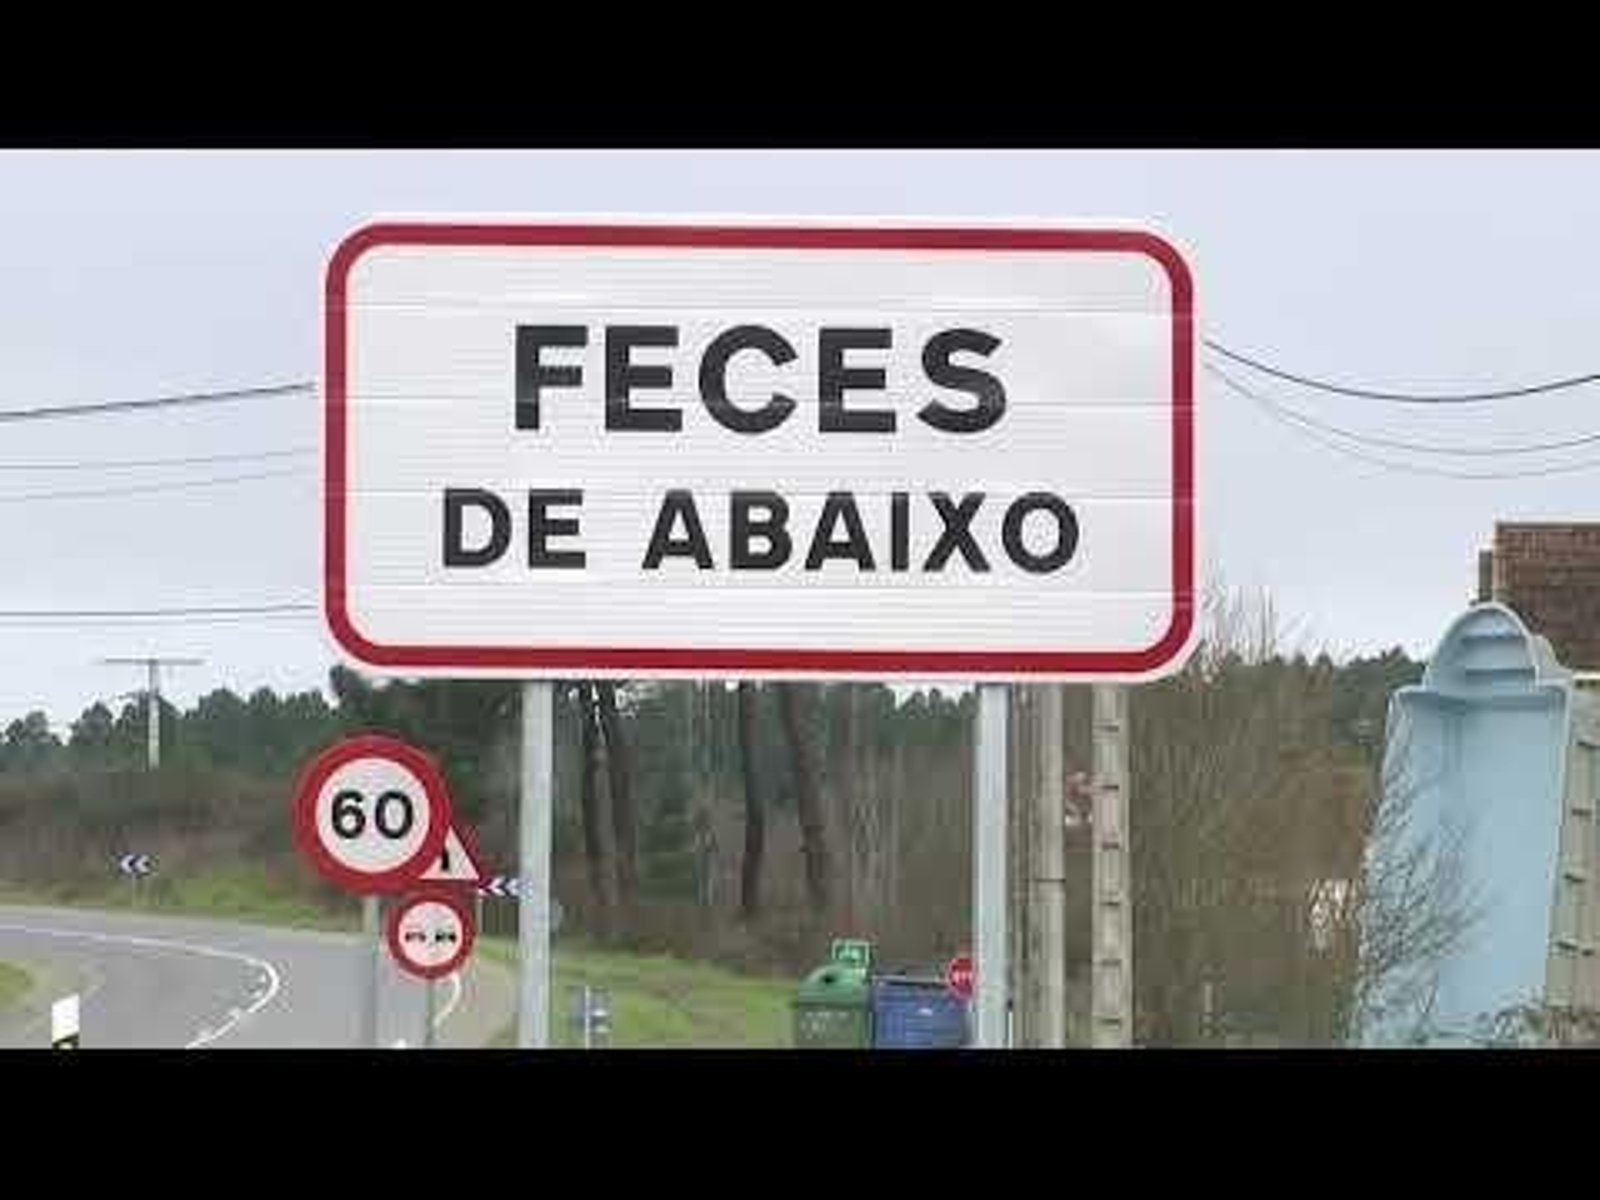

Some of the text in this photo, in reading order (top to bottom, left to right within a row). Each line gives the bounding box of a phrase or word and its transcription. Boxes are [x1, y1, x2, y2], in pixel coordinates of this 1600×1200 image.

[515, 325, 1007, 434] FECES
[442, 488, 1080, 574] DE ABAIXO
[331, 790, 413, 840] 60
